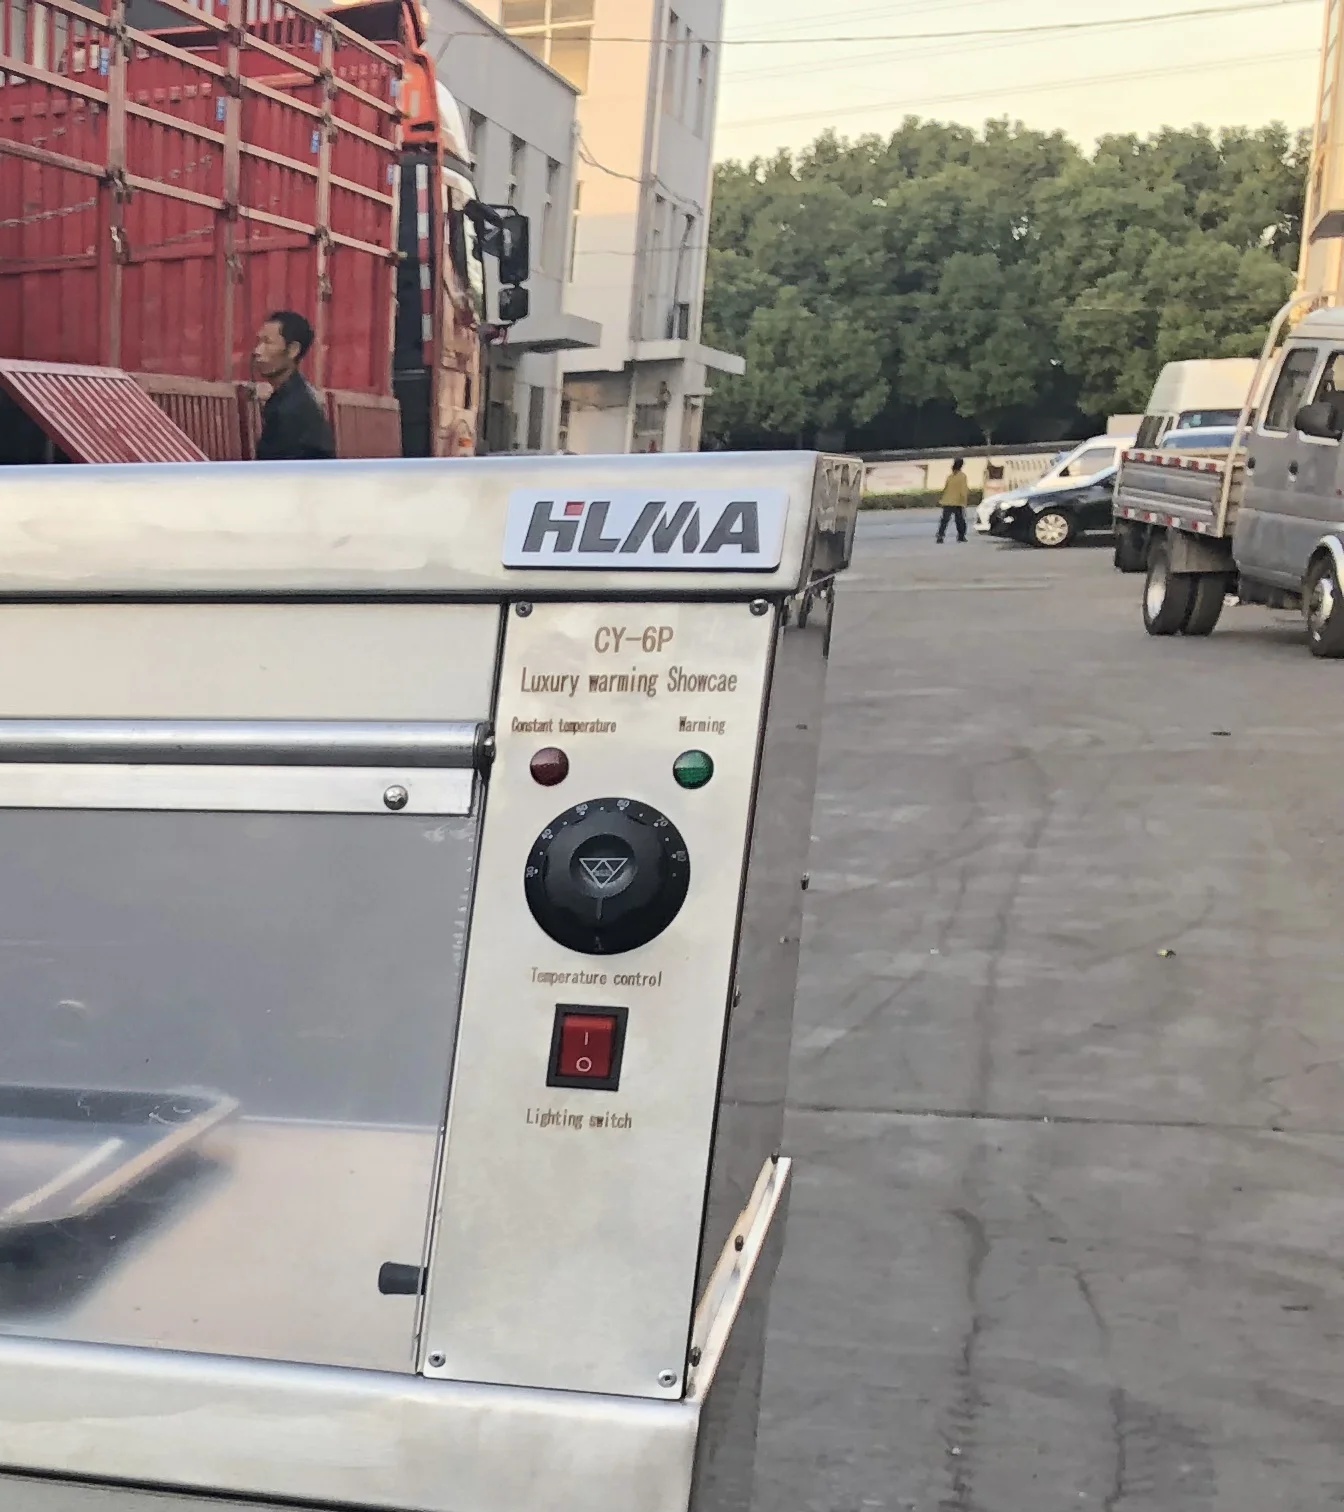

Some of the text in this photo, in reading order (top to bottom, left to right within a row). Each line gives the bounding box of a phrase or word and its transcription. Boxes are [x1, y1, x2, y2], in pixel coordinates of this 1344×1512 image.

[594, 626, 674, 653] CY-6P
[521, 666, 738, 697] Luxury warming Showcae
[512, 716, 617, 735] Constant temperature
[678, 716, 726, 735] Warming
[530, 967, 663, 987] Temperature control
[526, 1108, 632, 1130] Lighting switch
